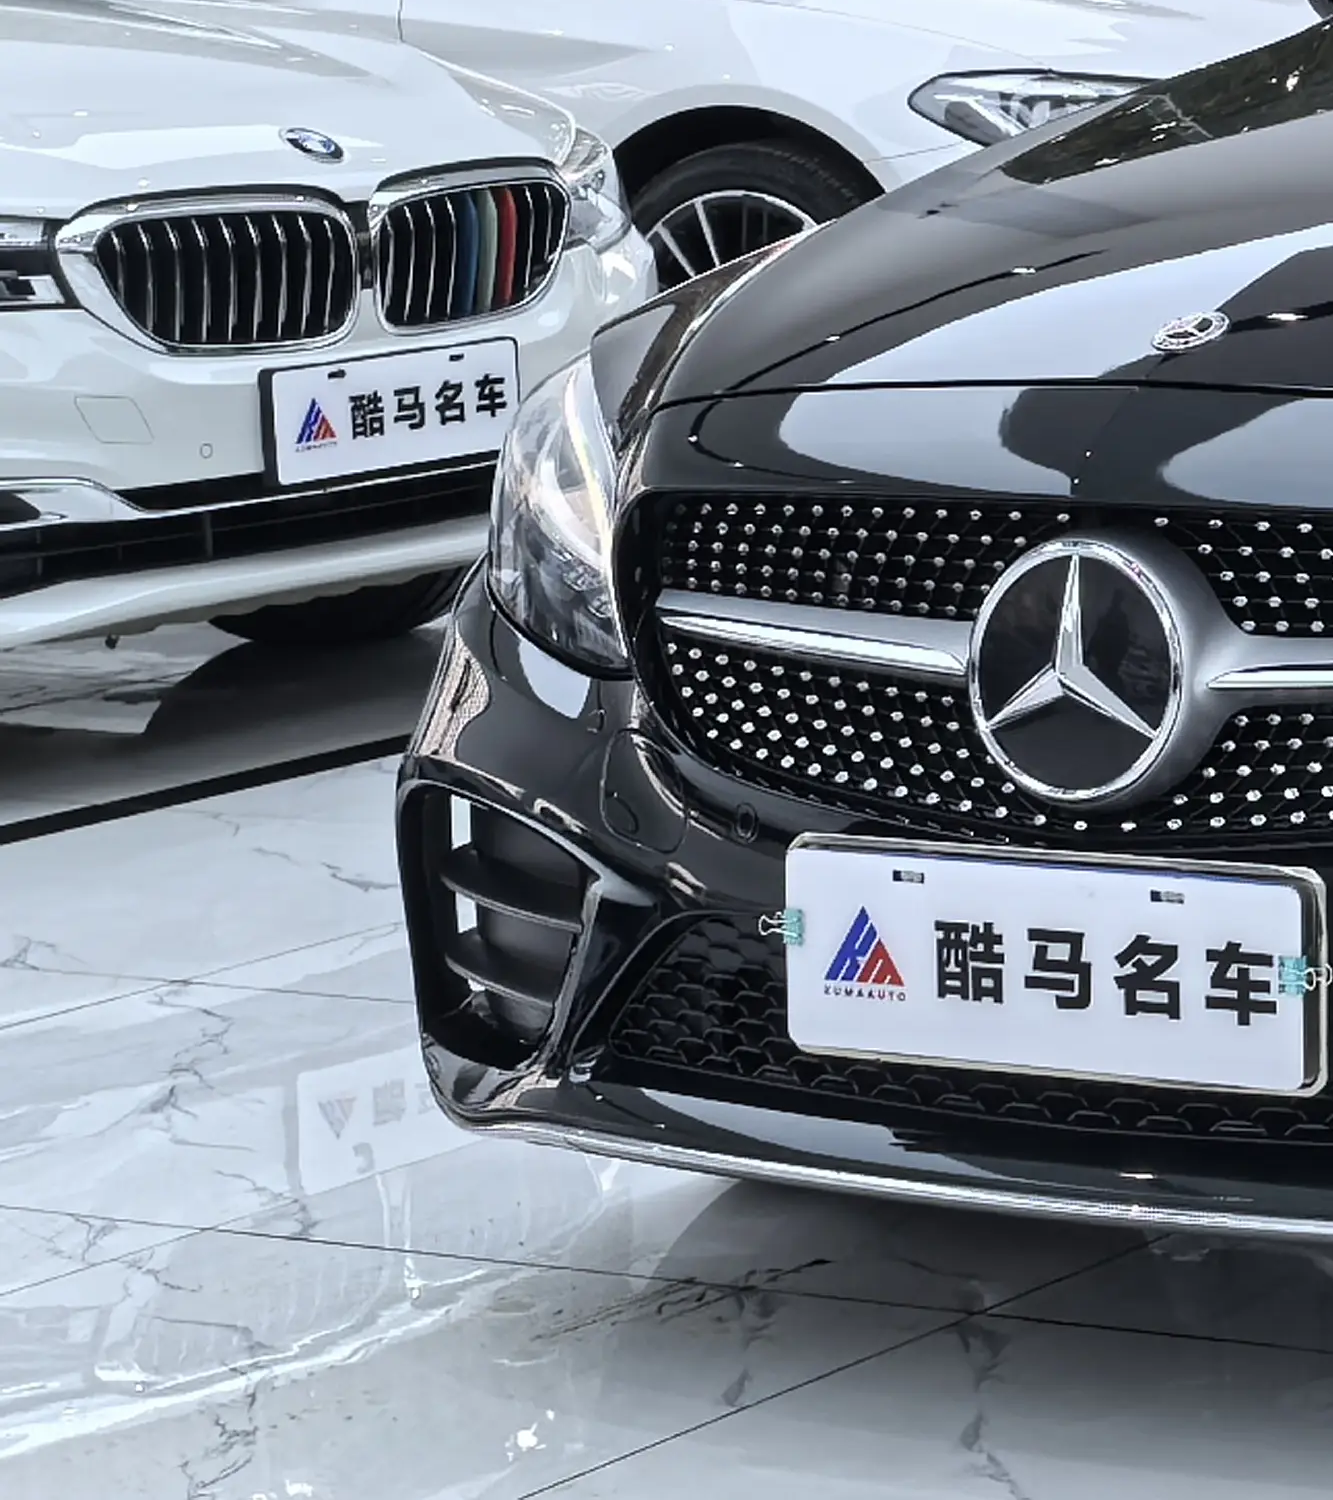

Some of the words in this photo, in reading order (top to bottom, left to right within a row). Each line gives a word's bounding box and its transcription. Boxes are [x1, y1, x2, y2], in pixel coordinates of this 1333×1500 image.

[348, 373, 508, 440] 酷马名车
[934, 919, 1278, 1027] 酷马名车
